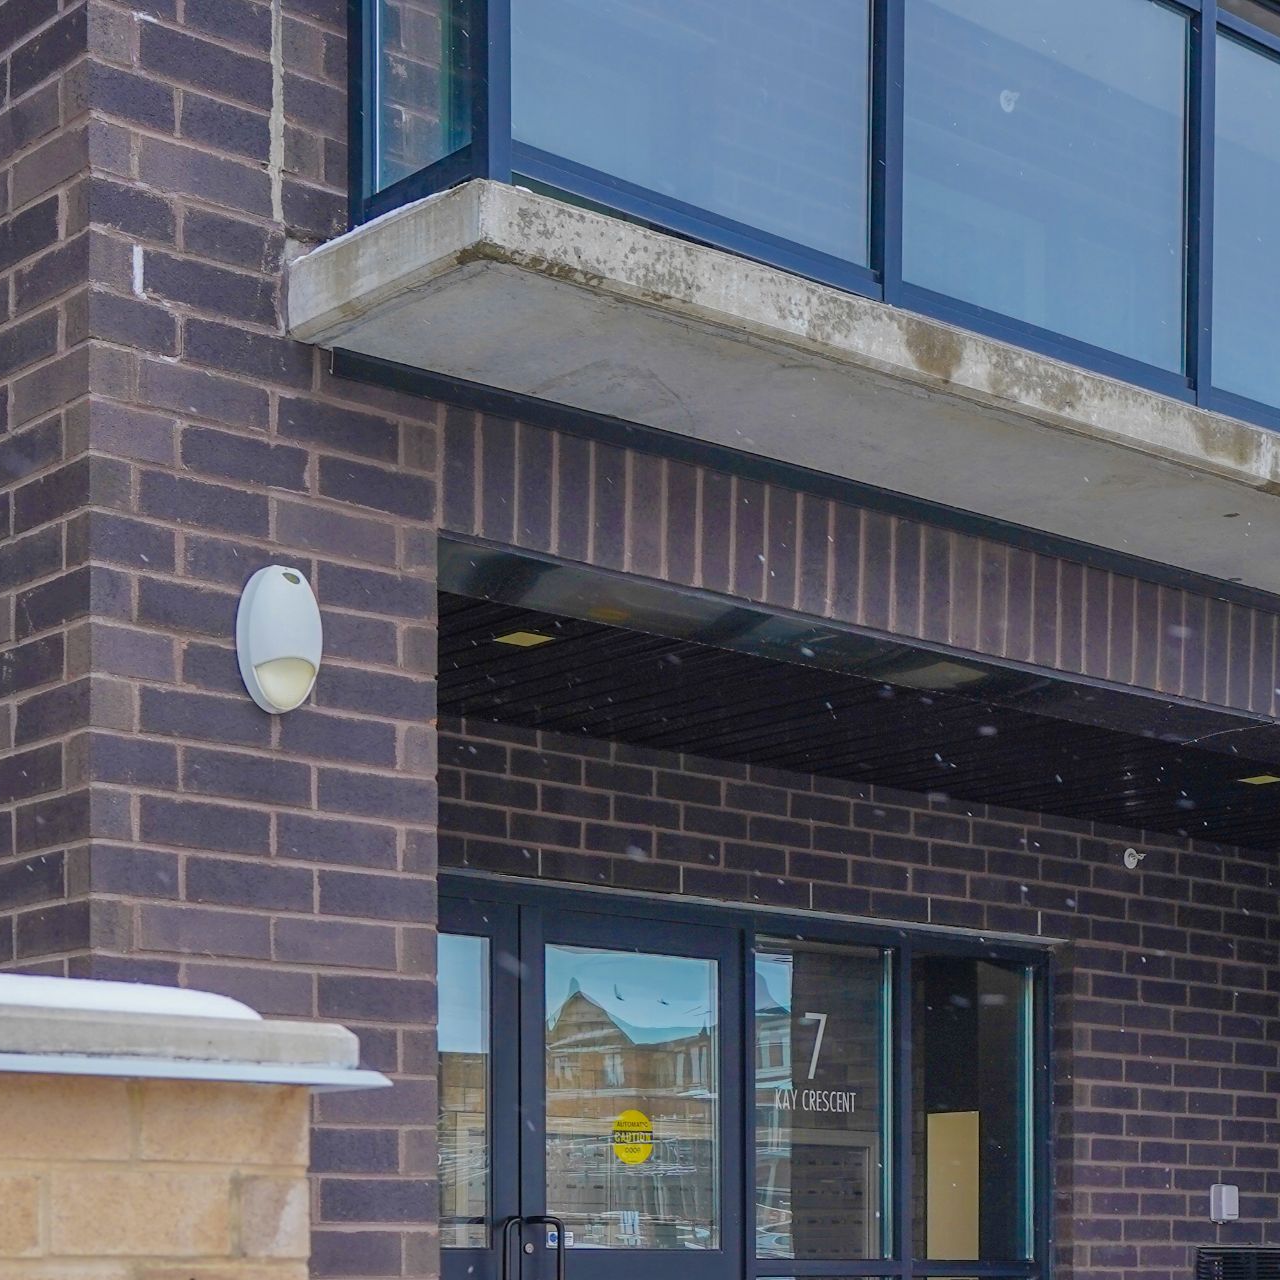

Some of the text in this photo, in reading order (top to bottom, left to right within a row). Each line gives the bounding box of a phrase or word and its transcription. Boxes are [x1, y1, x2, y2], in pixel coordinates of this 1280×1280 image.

[805, 1012, 827, 1079] 7
[775, 1088, 856, 1112] KAY CRESCENT
[614, 1131, 651, 1143] CAUTION
